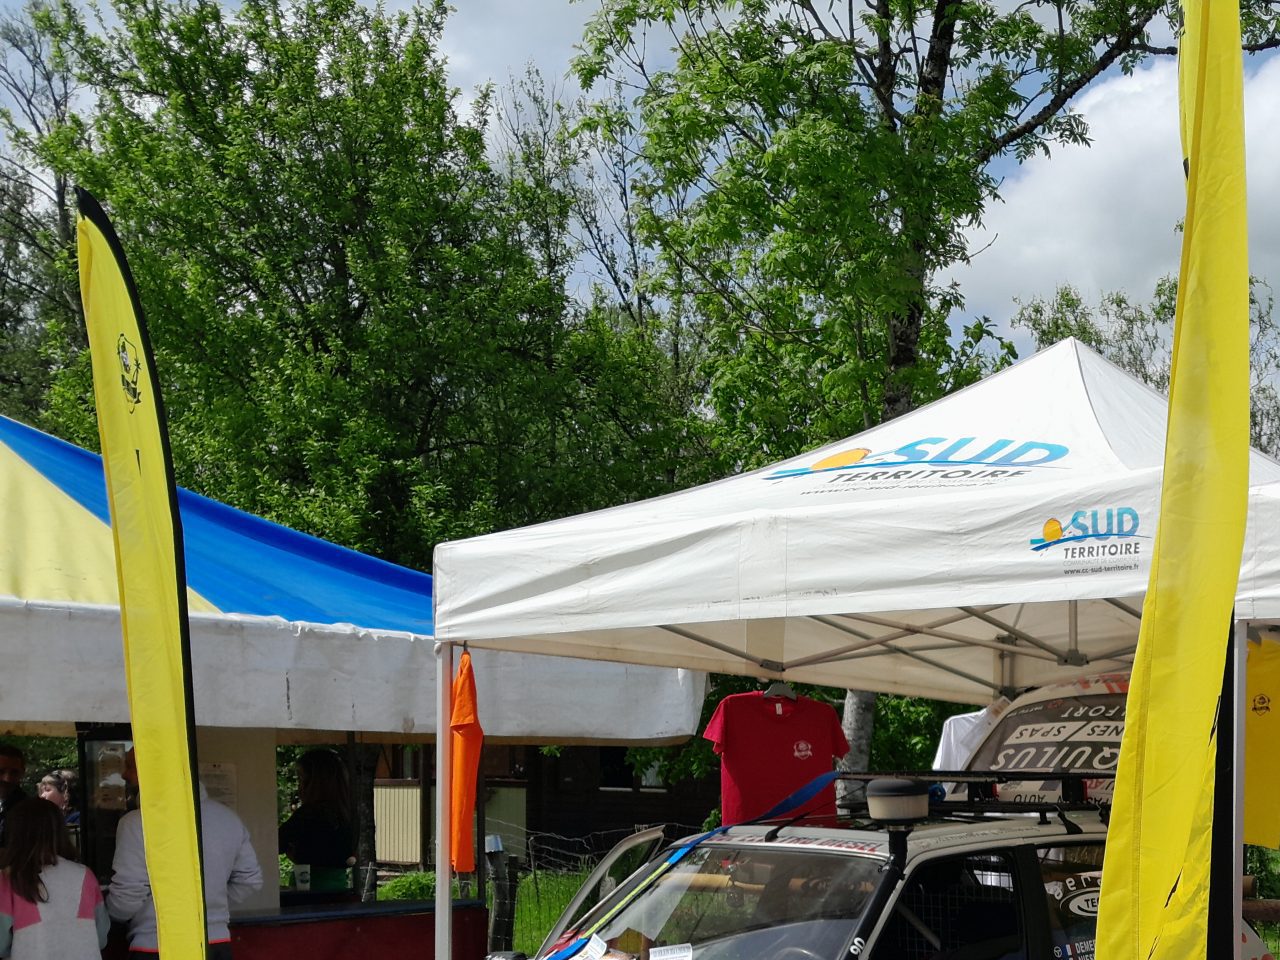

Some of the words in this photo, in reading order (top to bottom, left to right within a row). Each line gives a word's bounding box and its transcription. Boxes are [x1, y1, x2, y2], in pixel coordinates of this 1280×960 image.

[877, 437, 1069, 467] SUD
[827, 469, 1032, 483] TERRITOIRE
[1072, 507, 1140, 543] SUD
[1063, 542, 1140, 559] TERRITOIRE
[1063, 564, 1139, 575] www.cc-sud-territoire.fr
[1061, 705, 1121, 718] FORT
[1015, 725, 1066, 740] SPAS
[1087, 725, 1125, 737] NES
[989, 746, 1118, 771] QUILUS
[849, 936, 866, 957] 90
